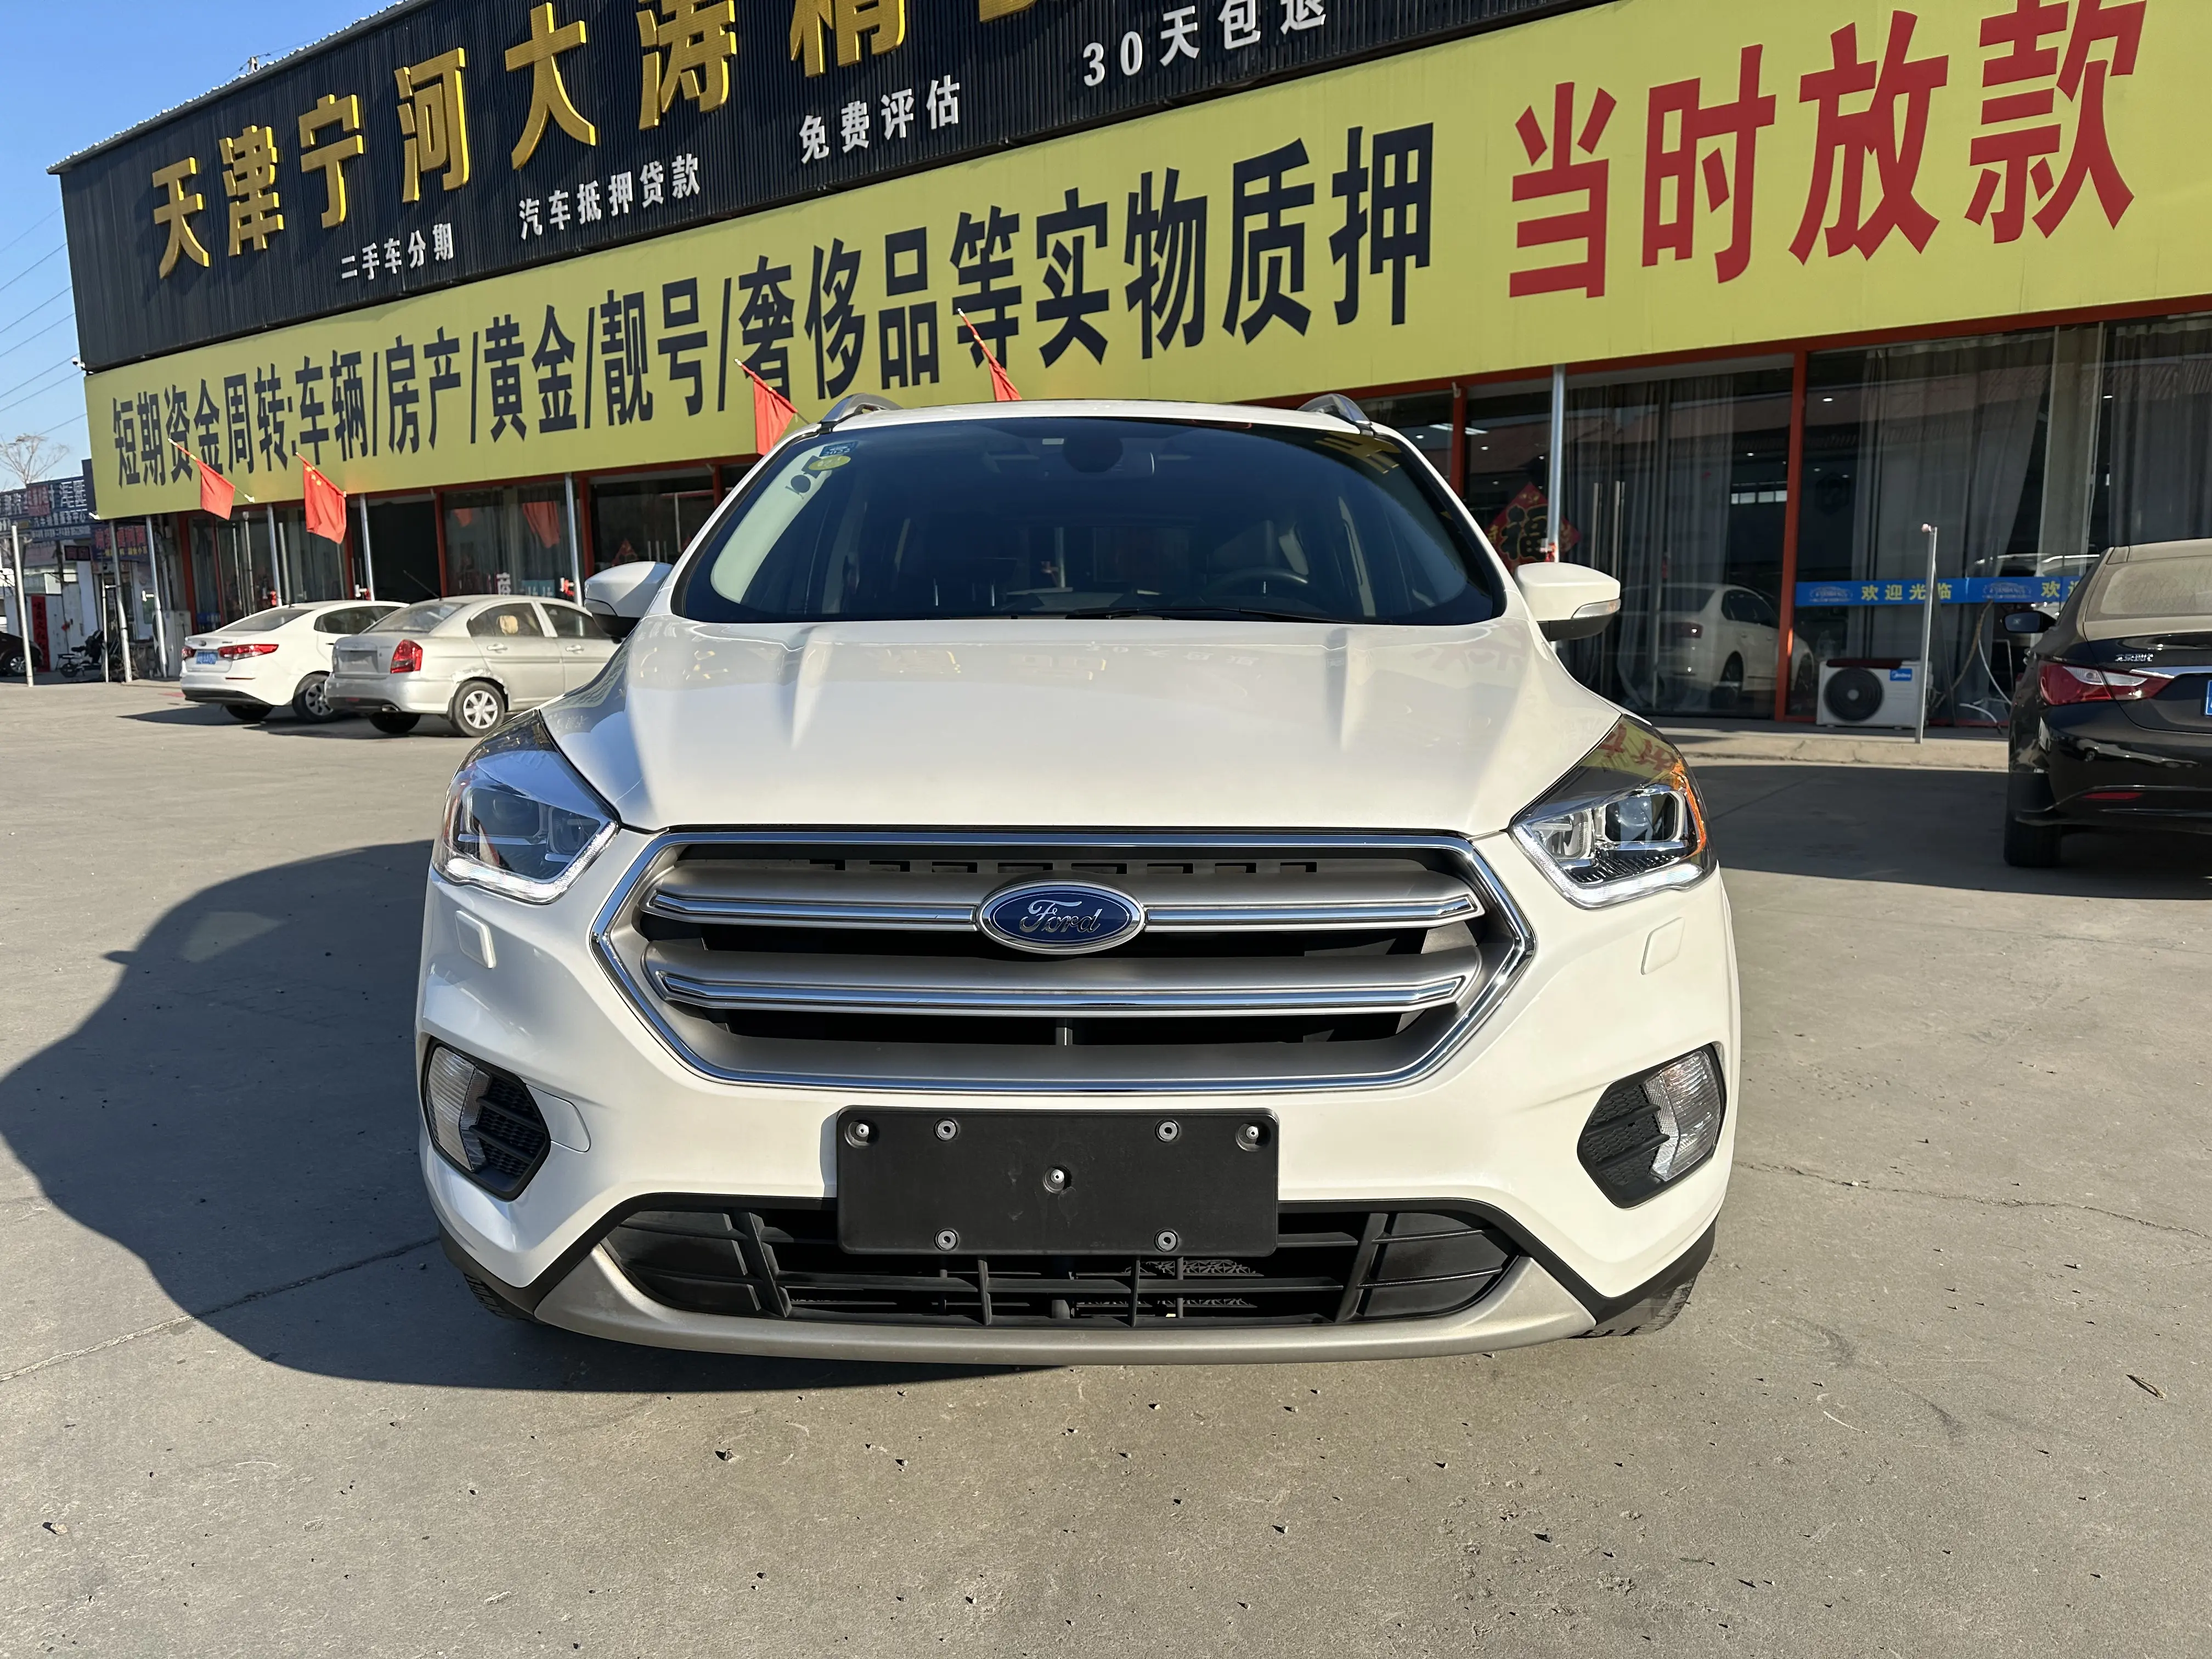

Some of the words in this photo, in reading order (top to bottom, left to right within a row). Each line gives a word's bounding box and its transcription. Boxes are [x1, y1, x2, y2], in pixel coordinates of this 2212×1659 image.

[153, 0, 1037, 280] 天津宁河大涛
[341, 222, 454, 281] 二手车分期
[518, 153, 701, 240] 汽车抵押贷款
[799, 75, 961, 164] 免费评估
[1509, 0, 2147, 299] 当时放款
[1860, 582, 1953, 601] 欢迎光临
[1019, 899, 1103, 933] Ford
